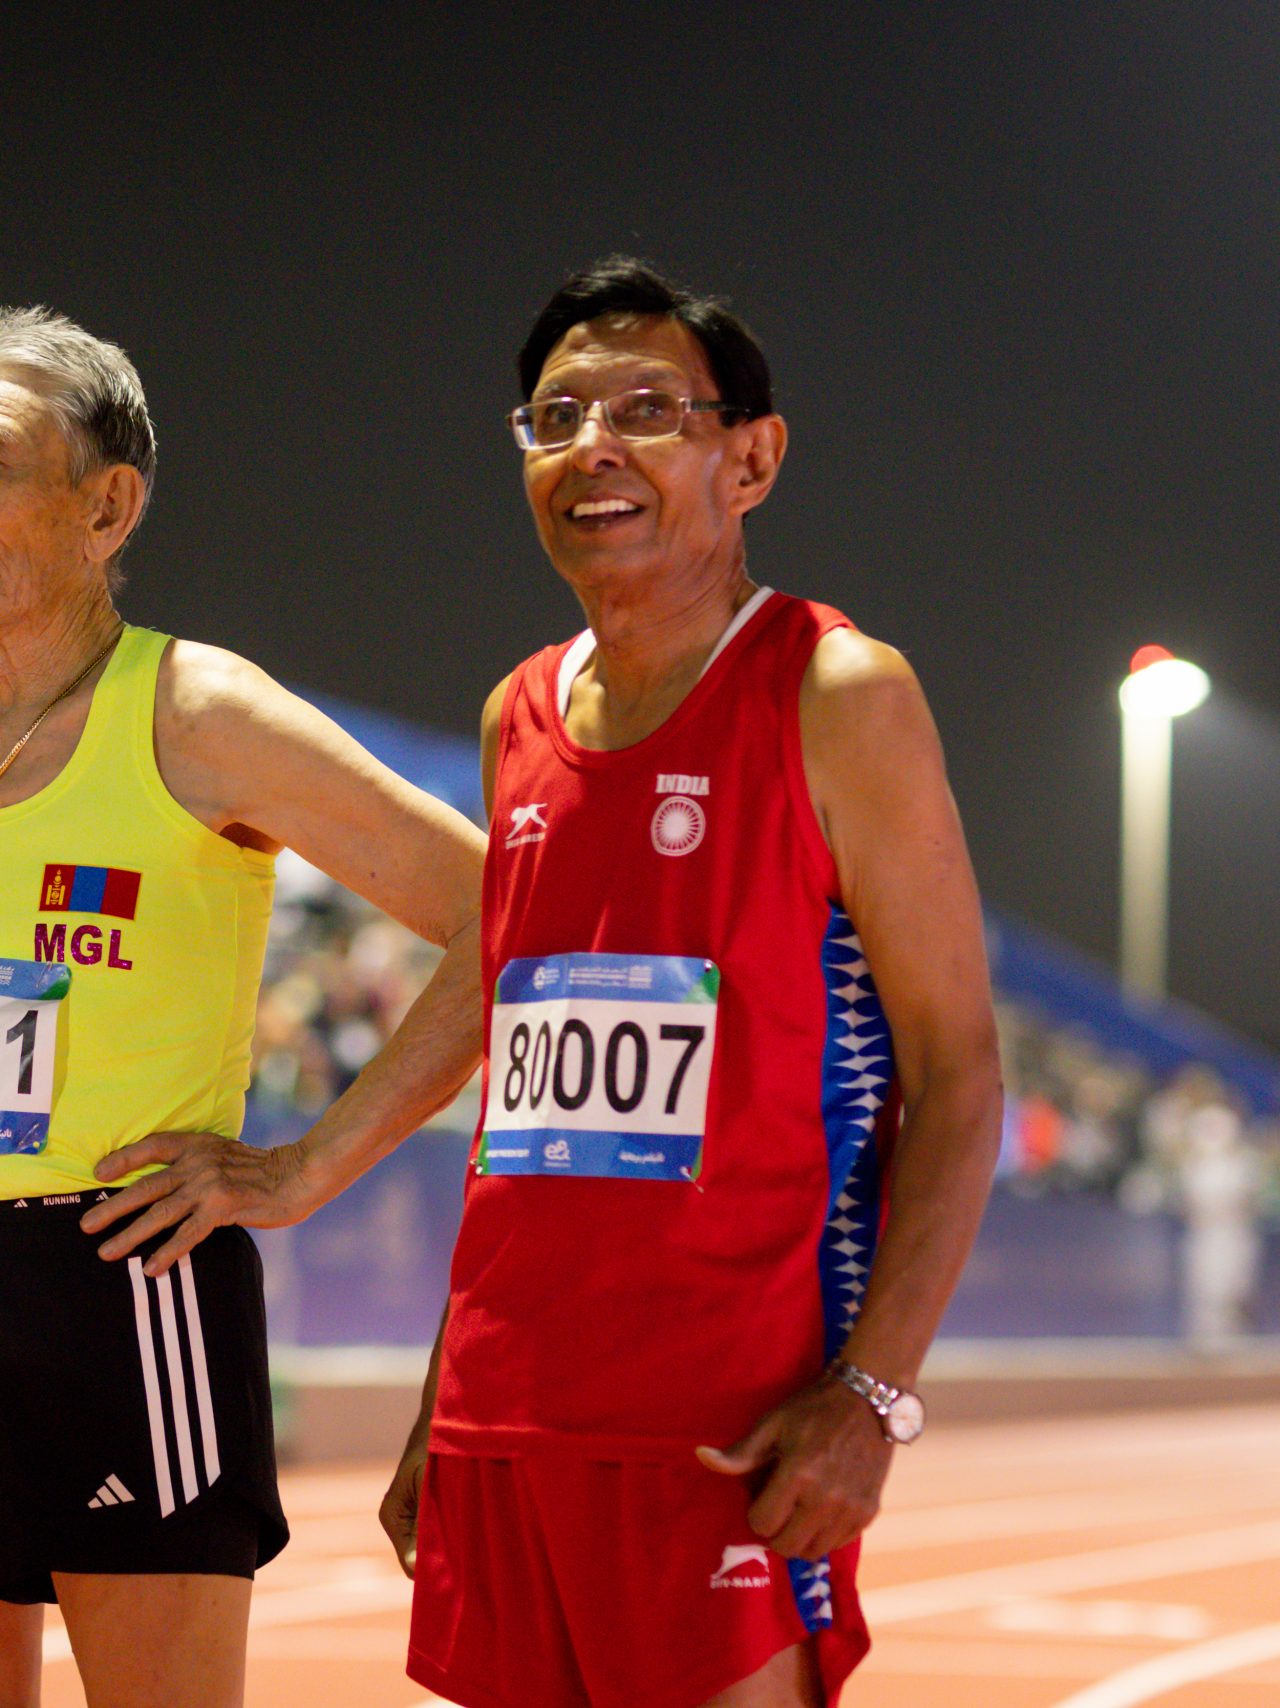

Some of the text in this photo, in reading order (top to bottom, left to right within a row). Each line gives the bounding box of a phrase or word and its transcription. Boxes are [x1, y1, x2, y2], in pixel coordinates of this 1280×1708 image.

[656, 774, 709, 796] INDIA
[34, 923, 132, 970] MGL
[504, 1018, 705, 1115] 80007
[43, 1193, 81, 1206] RUNNING
